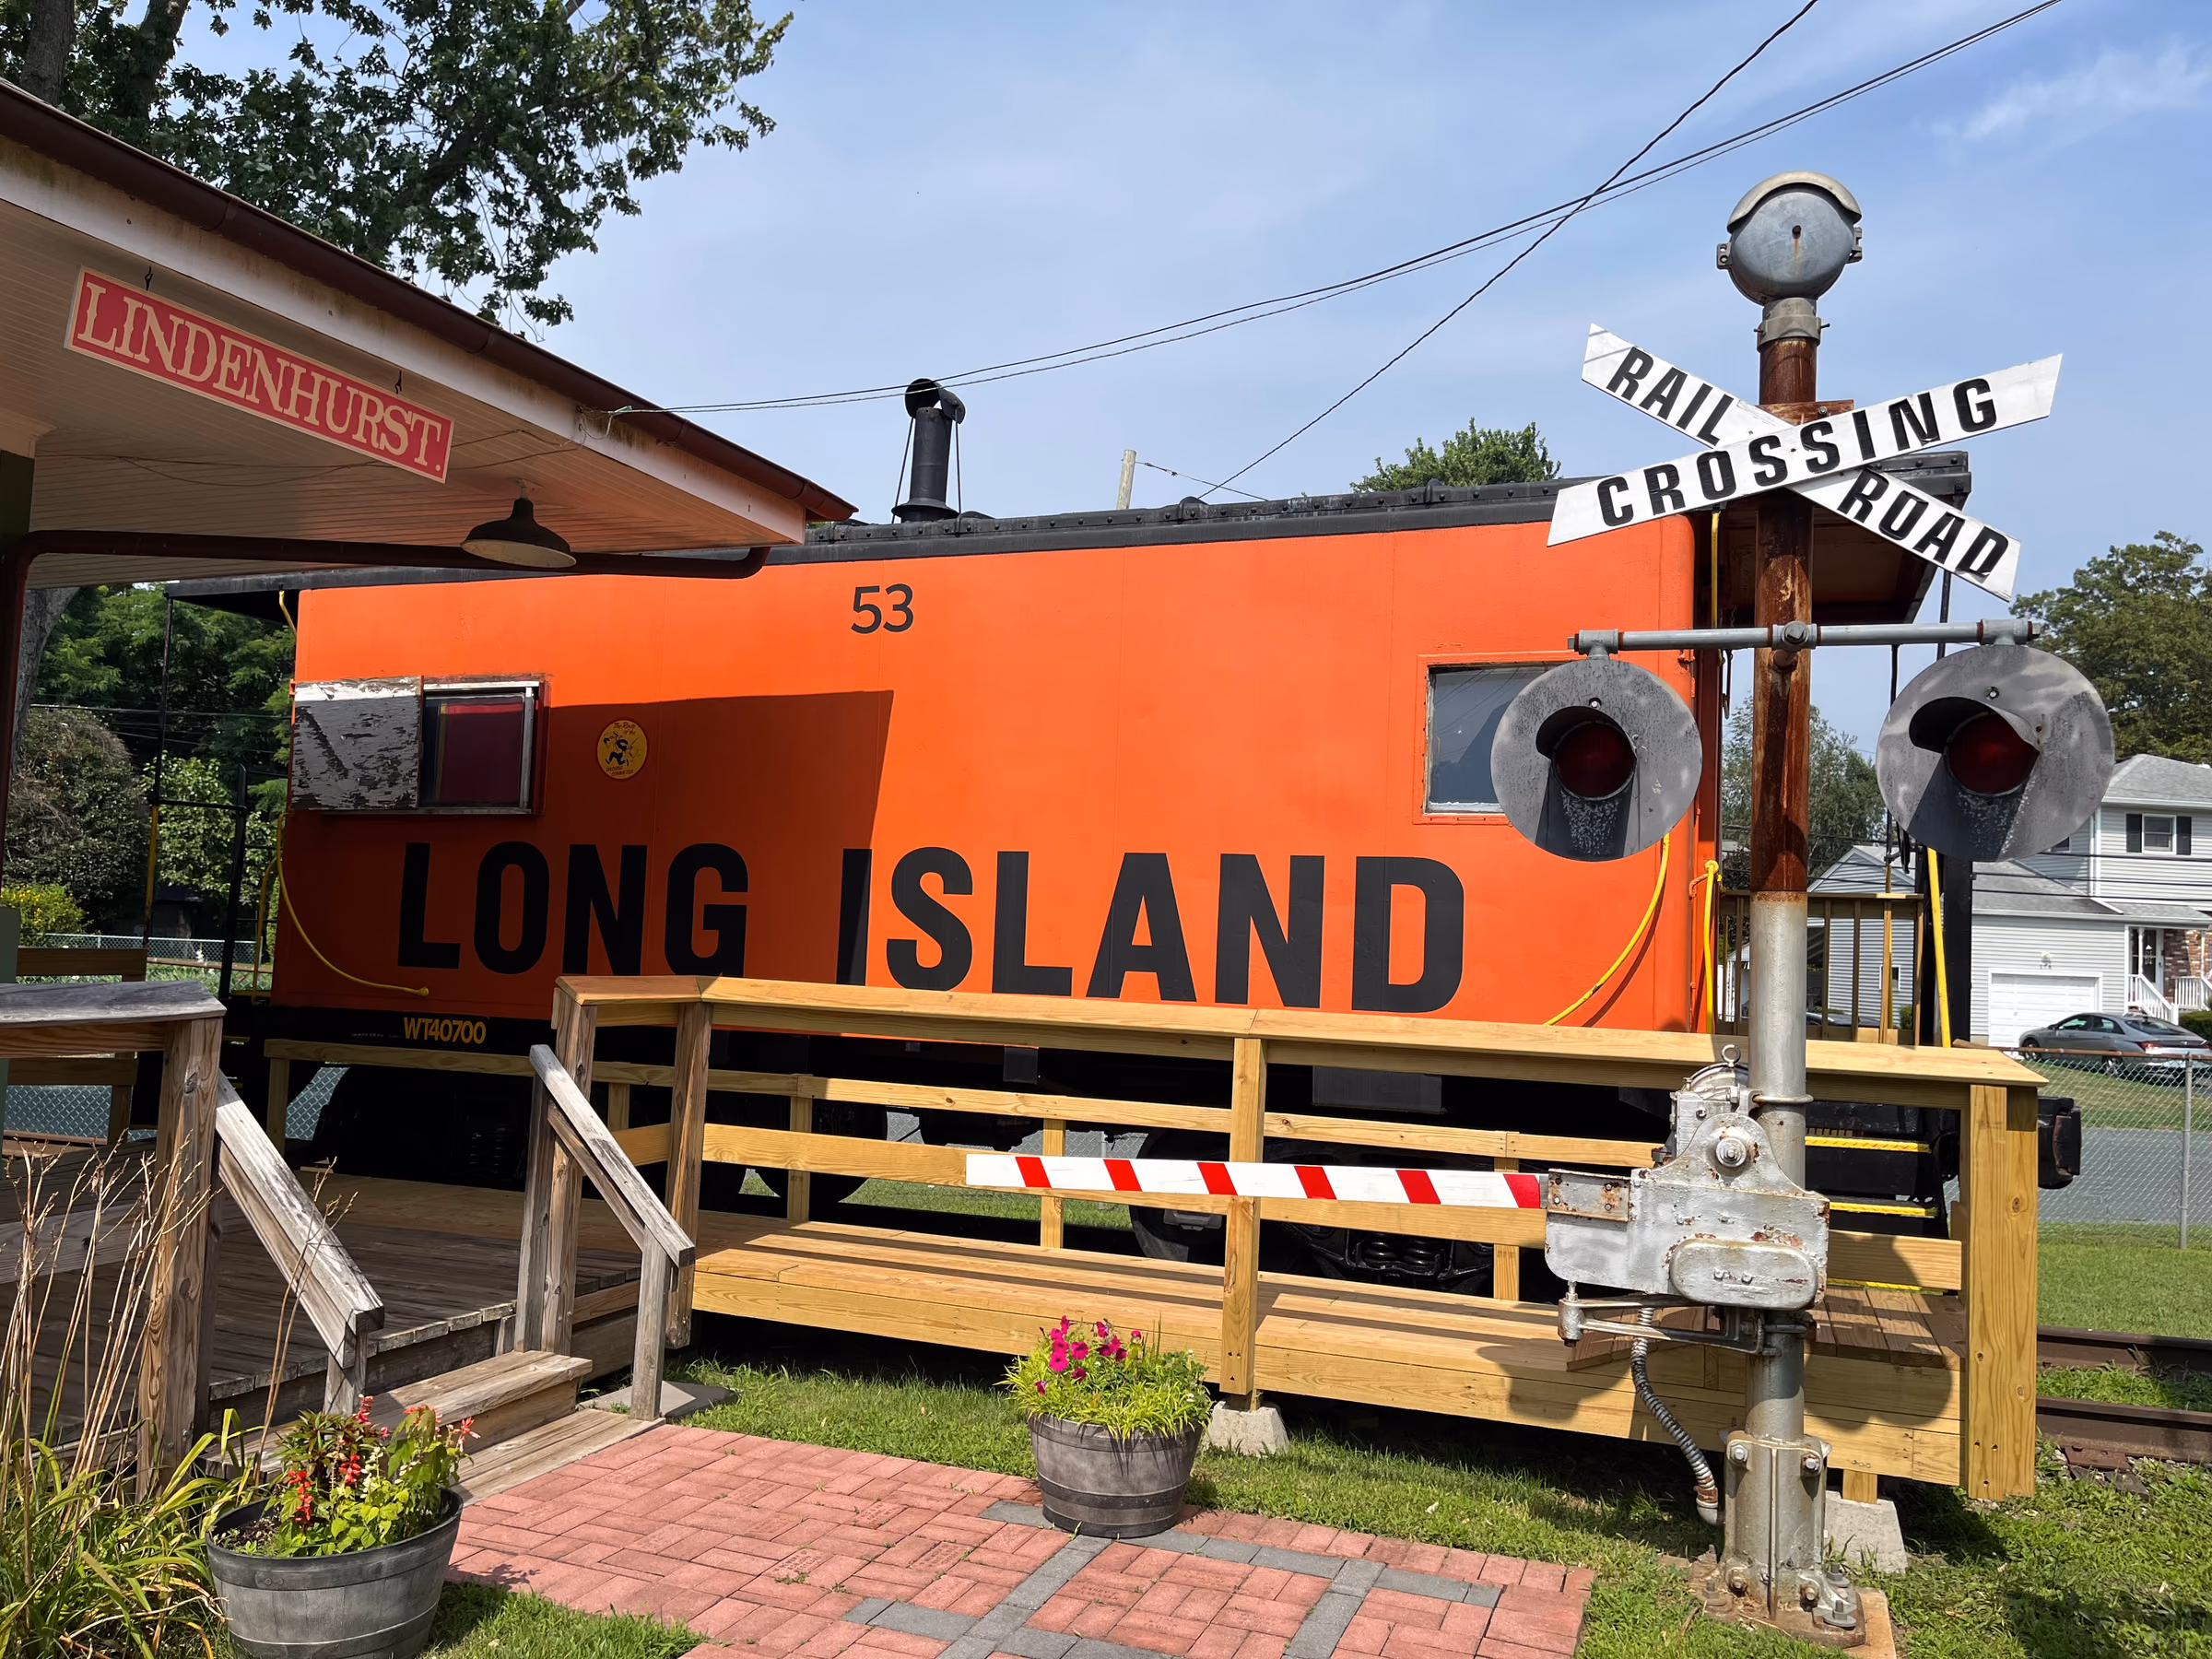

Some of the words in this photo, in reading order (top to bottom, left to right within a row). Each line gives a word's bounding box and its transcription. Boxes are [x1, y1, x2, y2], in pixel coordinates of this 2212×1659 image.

[77, 282, 442, 472] LINDENHURST.
[1597, 378, 1997, 527] CROSSING
[1606, 347, 1735, 447] RAIL
[1838, 468, 2009, 579] ROAD
[851, 583, 914, 634] 53
[397, 841, 749, 977] LONG
[836, 846, 1465, 1013] ISLAND
[404, 1017, 487, 1044] WT40700
